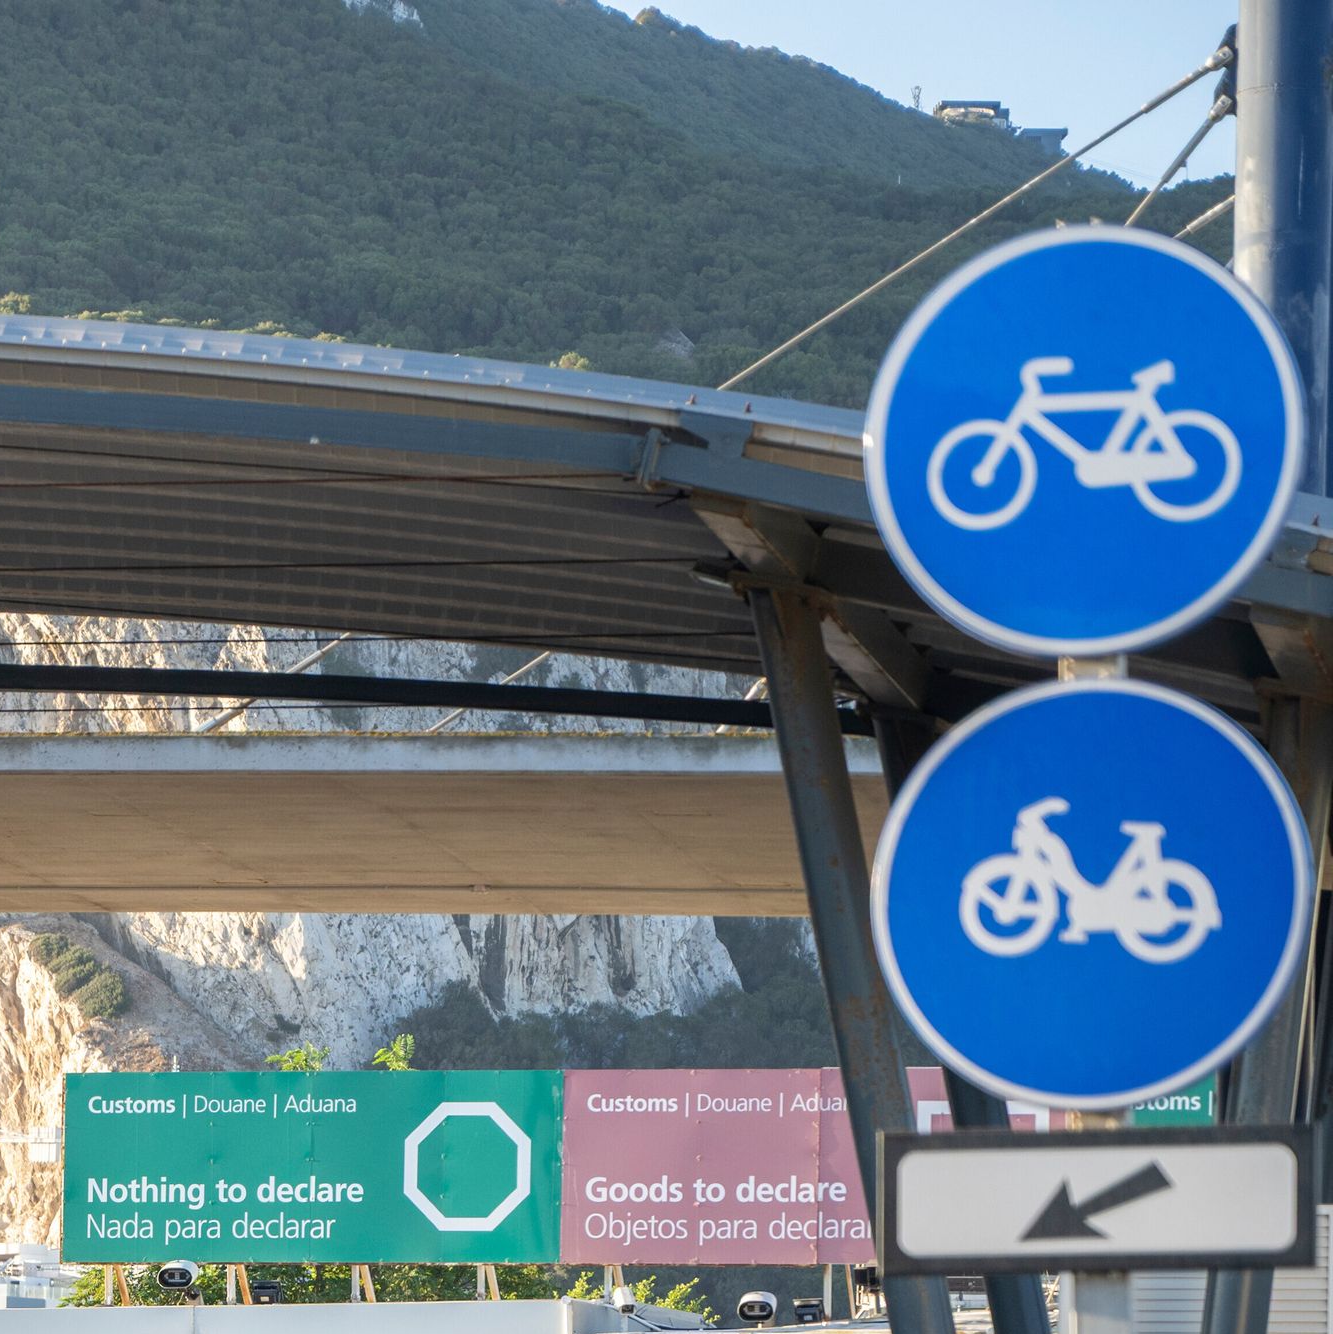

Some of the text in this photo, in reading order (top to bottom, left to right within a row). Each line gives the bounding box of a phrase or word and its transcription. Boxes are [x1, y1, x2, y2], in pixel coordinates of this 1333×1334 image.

[87, 1096, 176, 1114] Customs
[194, 1095, 266, 1113] Douane
[284, 1094, 357, 1113] Aduana
[587, 1094, 678, 1113] Customs
[697, 1094, 773, 1112] Douane
[87, 1176, 364, 1210] Nothing to declare
[585, 1175, 847, 1203] Goods to declare
[87, 1211, 336, 1245] Nada para declarar
[585, 1212, 688, 1246] Objetos
[699, 1218, 758, 1246] para
